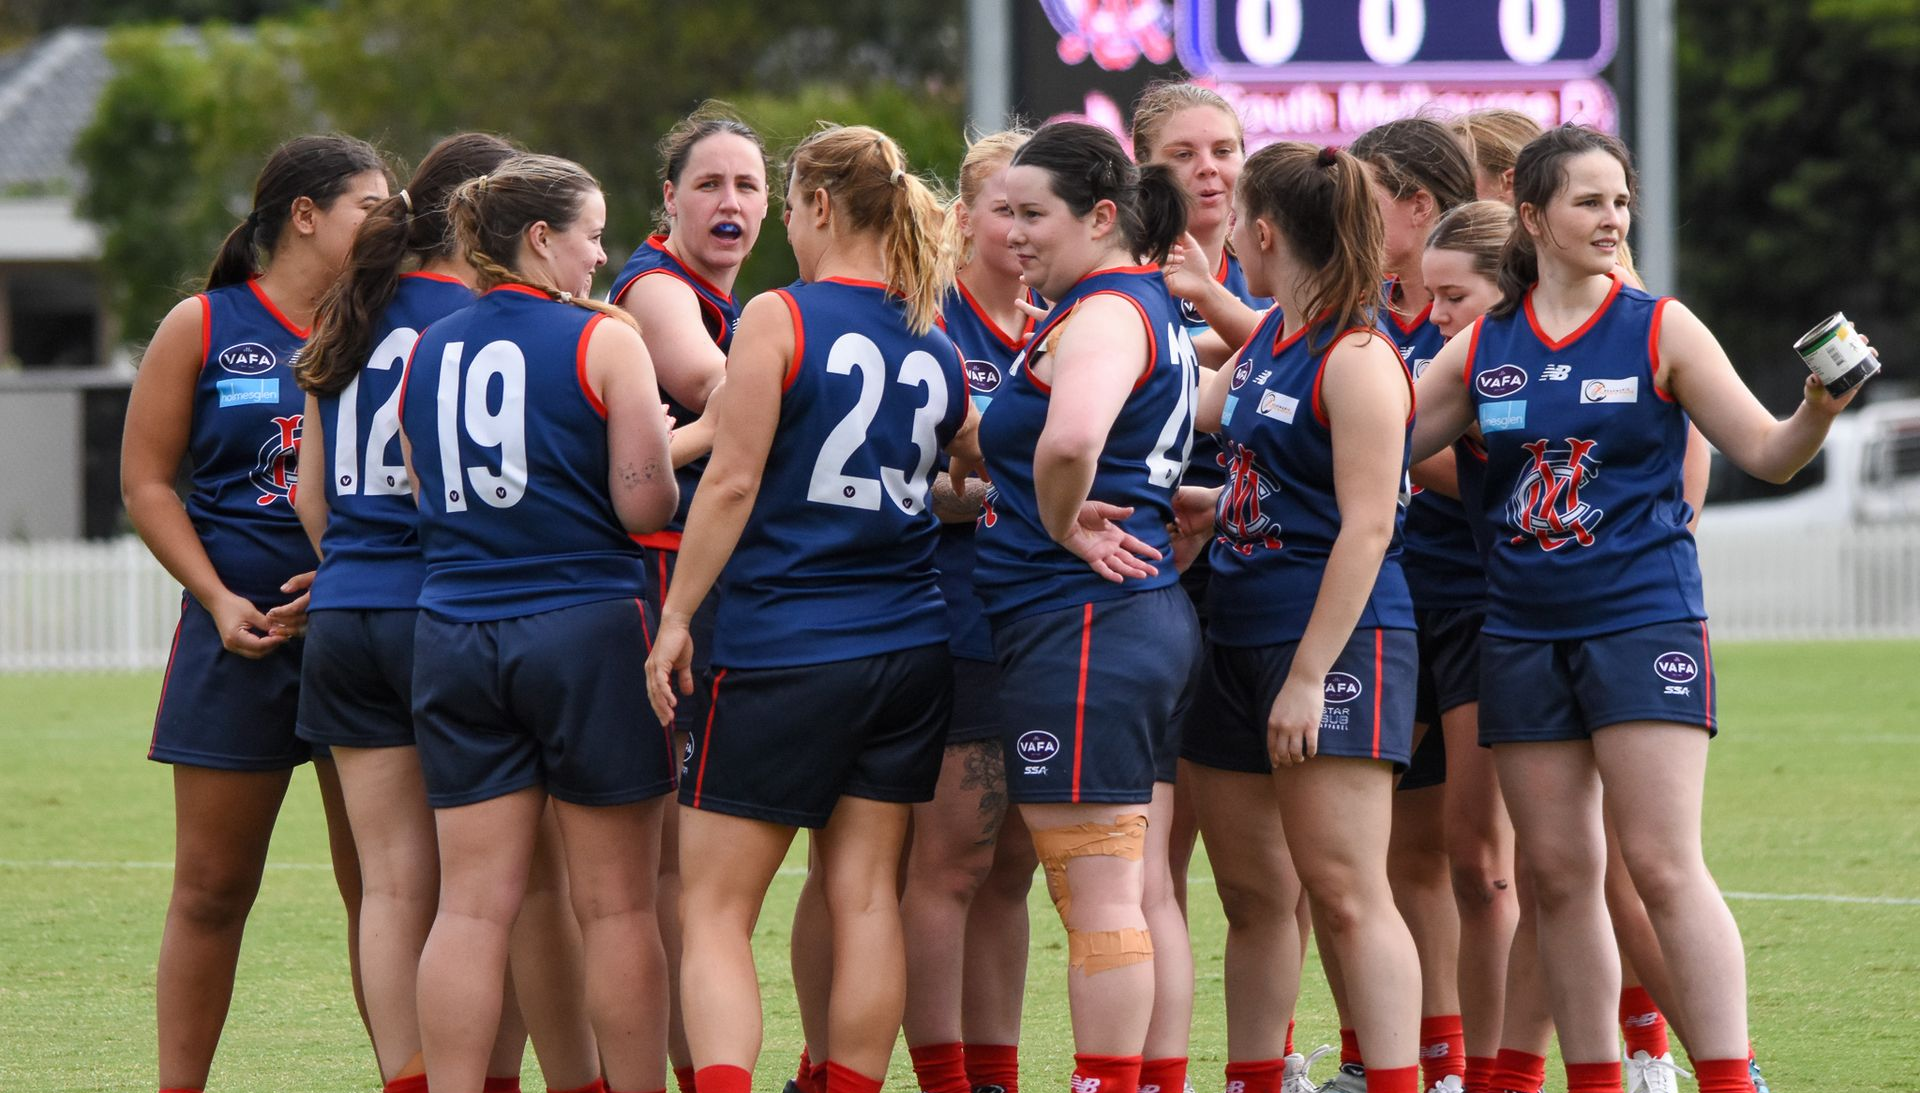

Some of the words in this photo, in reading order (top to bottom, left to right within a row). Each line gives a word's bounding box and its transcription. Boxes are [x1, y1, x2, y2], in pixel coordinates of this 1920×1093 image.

[1235, 0, 1301, 65] 0
[1358, 0, 1426, 65] 0
[1498, 0, 1566, 65] 0
[224, 353, 271, 366] VAFA
[1480, 375, 1522, 388] VAFA
[437, 340, 528, 513] 19
[806, 332, 949, 517] 23
[1658, 661, 1694, 674] VAFA
[1323, 682, 1357, 693] AFA
[1020, 741, 1055, 752] VAFA
